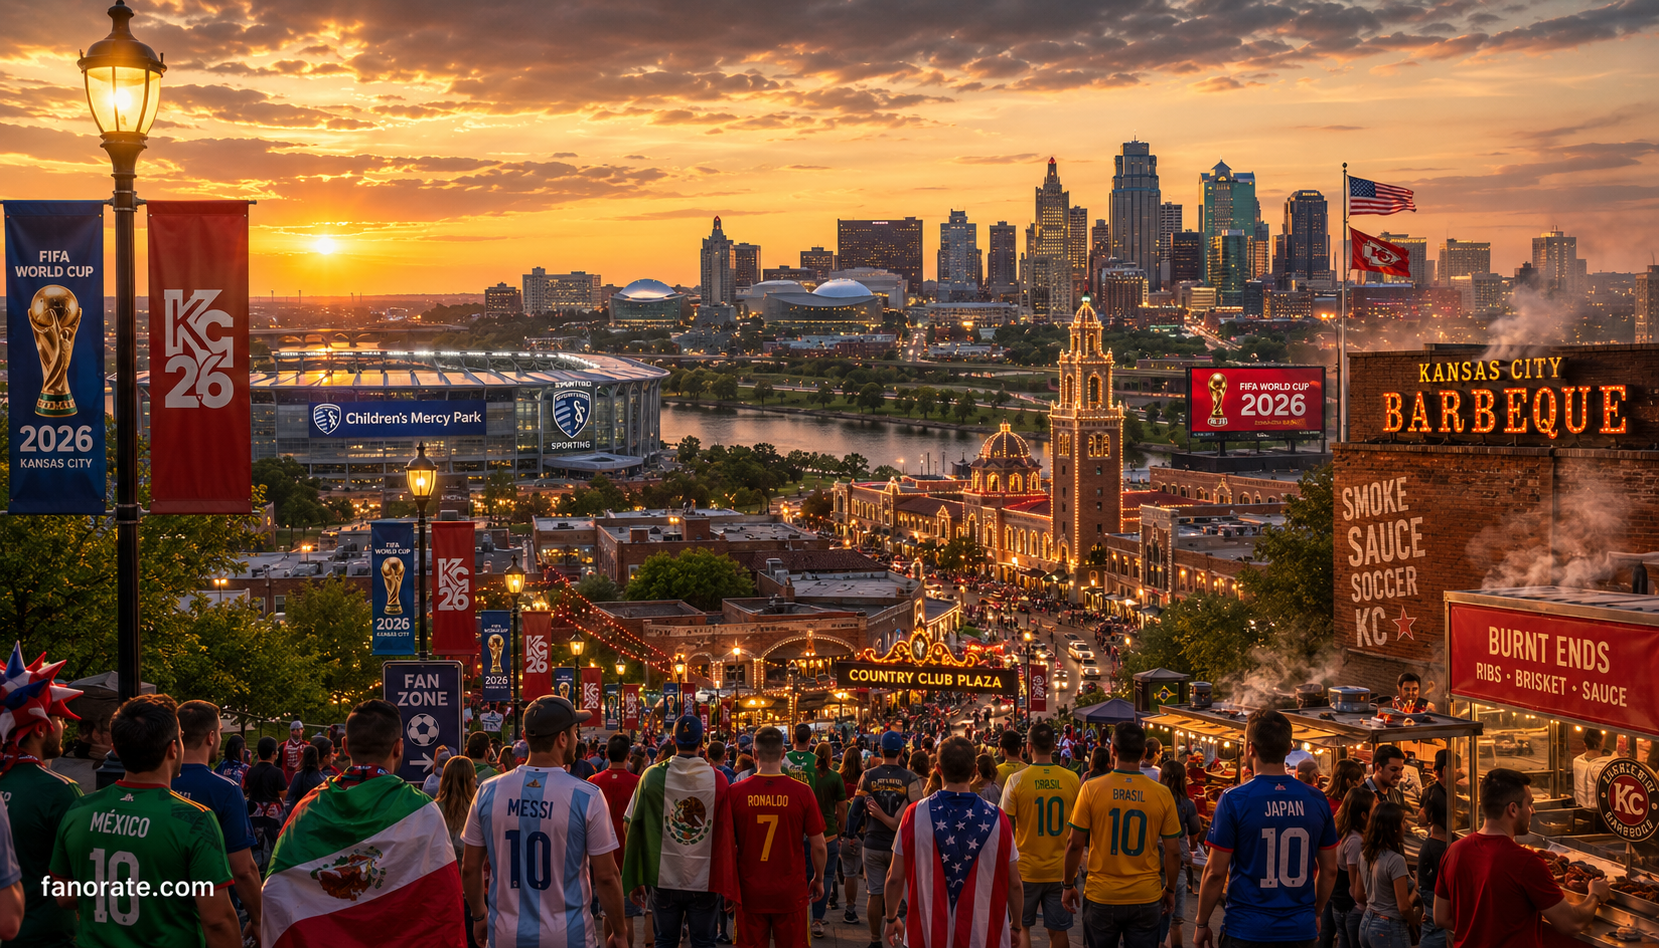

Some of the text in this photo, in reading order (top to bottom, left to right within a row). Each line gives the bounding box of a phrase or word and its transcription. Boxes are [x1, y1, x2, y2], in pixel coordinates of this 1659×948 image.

[39, 250, 70, 263] FIFA
[15, 266, 94, 278] WORLD CUP
[163, 289, 234, 368] KC
[164, 354, 234, 409] 26
[1418, 356, 1563, 383] KANSAS CITY
[1240, 382, 1310, 391] FIFA WORLD CUP
[1240, 393, 1306, 416] 2026
[1382, 384, 1628, 439] BARBEQUE
[345, 411, 482, 428] Children's Mercy Park
[19, 425, 94, 453] 2026
[20, 458, 93, 469] KANSAS CITY
[1341, 476, 1411, 522] SMOKE
[1347, 516, 1427, 568] SAUCE
[438, 558, 470, 593] KC
[1351, 566, 1420, 603] SOCCER
[438, 586, 470, 611] 26
[376, 618, 410, 631] 2026
[1355, 607, 1388, 649] KC
[526, 635, 548, 659] KC
[1488, 626, 1611, 674] BURNT ENDS
[526, 655, 548, 674] 26
[404, 674, 439, 689] FAN
[485, 676, 508, 685] 2026
[849, 669, 1003, 689] COUNTRY CLUB PLAZA
[1475, 661, 1628, 708] RIBS BRISKET SAUCE
[397, 691, 448, 707] ZONE
[507, 798, 554, 820] MESSI
[1112, 788, 1146, 803] BRASIL
[1264, 800, 1306, 818] JAPAN
[1613, 782, 1645, 816] KC
[90, 809, 151, 839] MÉXICO
[1034, 796, 1065, 837] 10
[756, 815, 780, 862] 7
[1108, 808, 1148, 857] 10
[505, 830, 551, 891] 10
[1260, 827, 1311, 889] 10
[89, 847, 141, 926] 10
